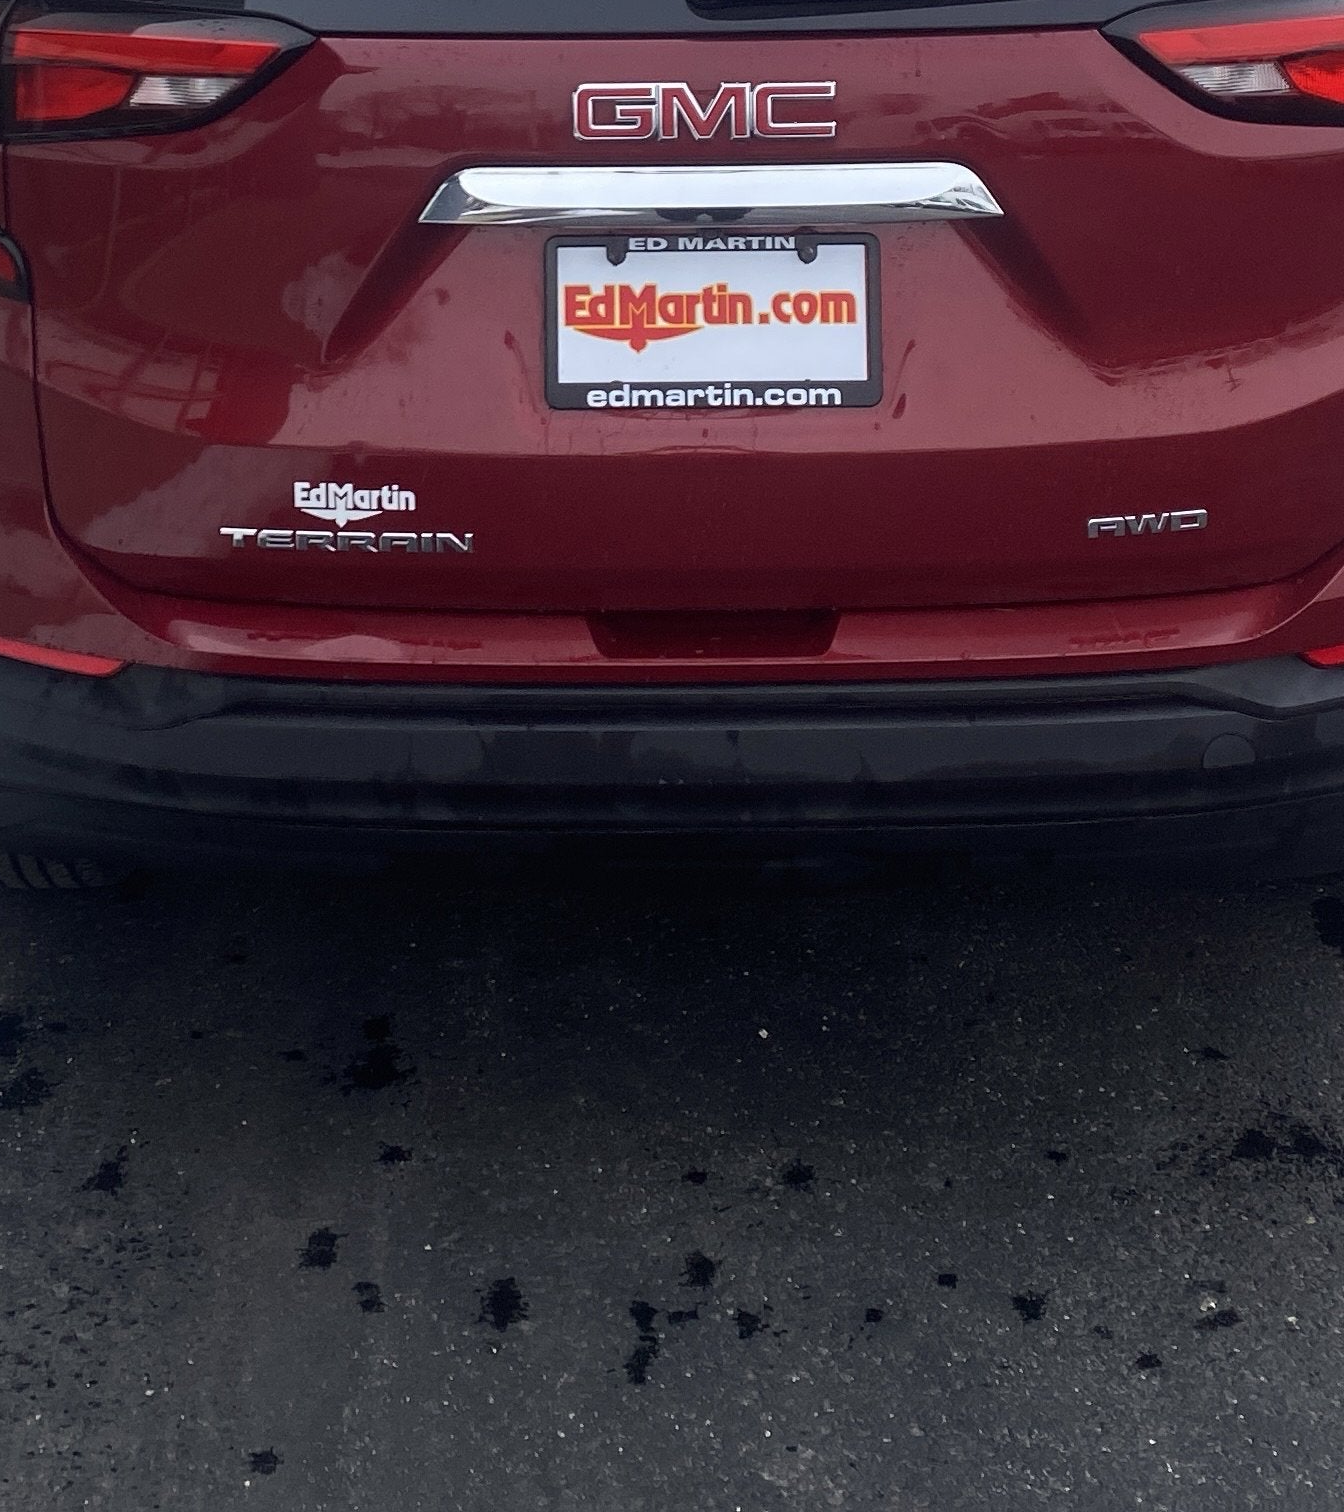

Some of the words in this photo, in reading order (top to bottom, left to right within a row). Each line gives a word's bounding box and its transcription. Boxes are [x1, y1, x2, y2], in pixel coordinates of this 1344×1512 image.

[572, 81, 837, 140] GMC
[627, 237, 661, 252] ED
[677, 236, 797, 251] MARTIN
[564, 283, 857, 328] EdMartin.com
[586, 382, 842, 408] edmartin.com
[293, 481, 416, 513] EdMartin
[1087, 508, 1208, 539] AWD
[219, 526, 474, 553] TERRAIN
